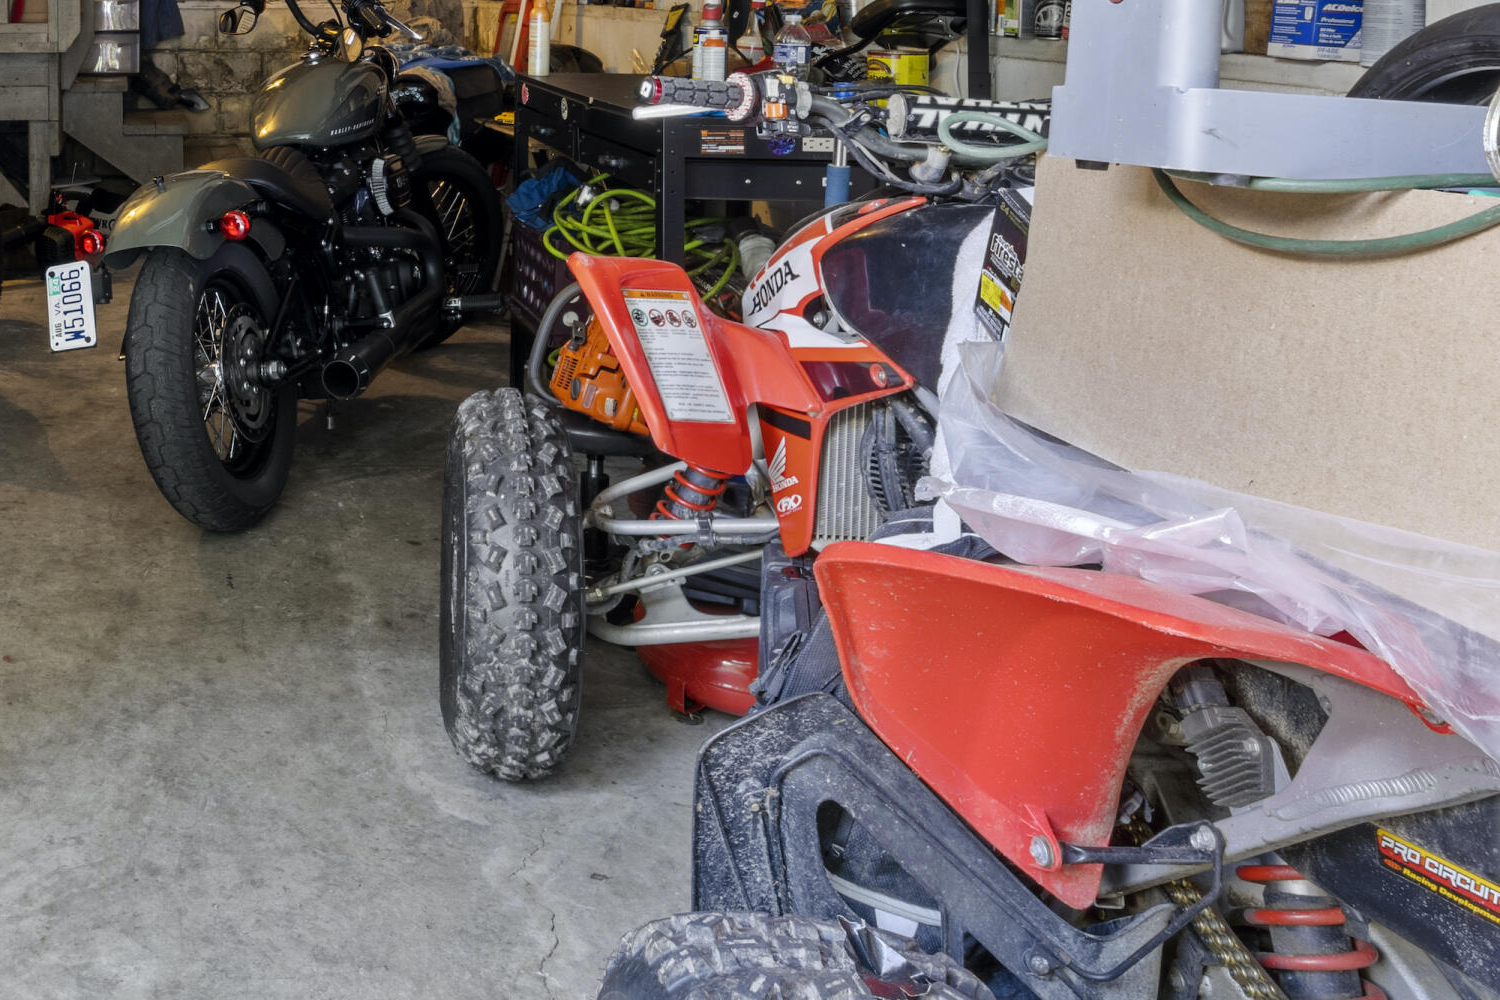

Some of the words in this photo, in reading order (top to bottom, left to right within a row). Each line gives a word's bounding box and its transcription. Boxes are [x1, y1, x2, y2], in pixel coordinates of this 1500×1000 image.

[330, 118, 375, 136] HARLEY-DAVIDSON
[59, 268, 86, 342] W51066
[747, 259, 801, 317] HONDA
[773, 475, 799, 493] HONDA
[1381, 835, 1421, 866] PRO
[1424, 857, 1500, 905] CIRCUIT
[1402, 868, 1438, 892] Racing
